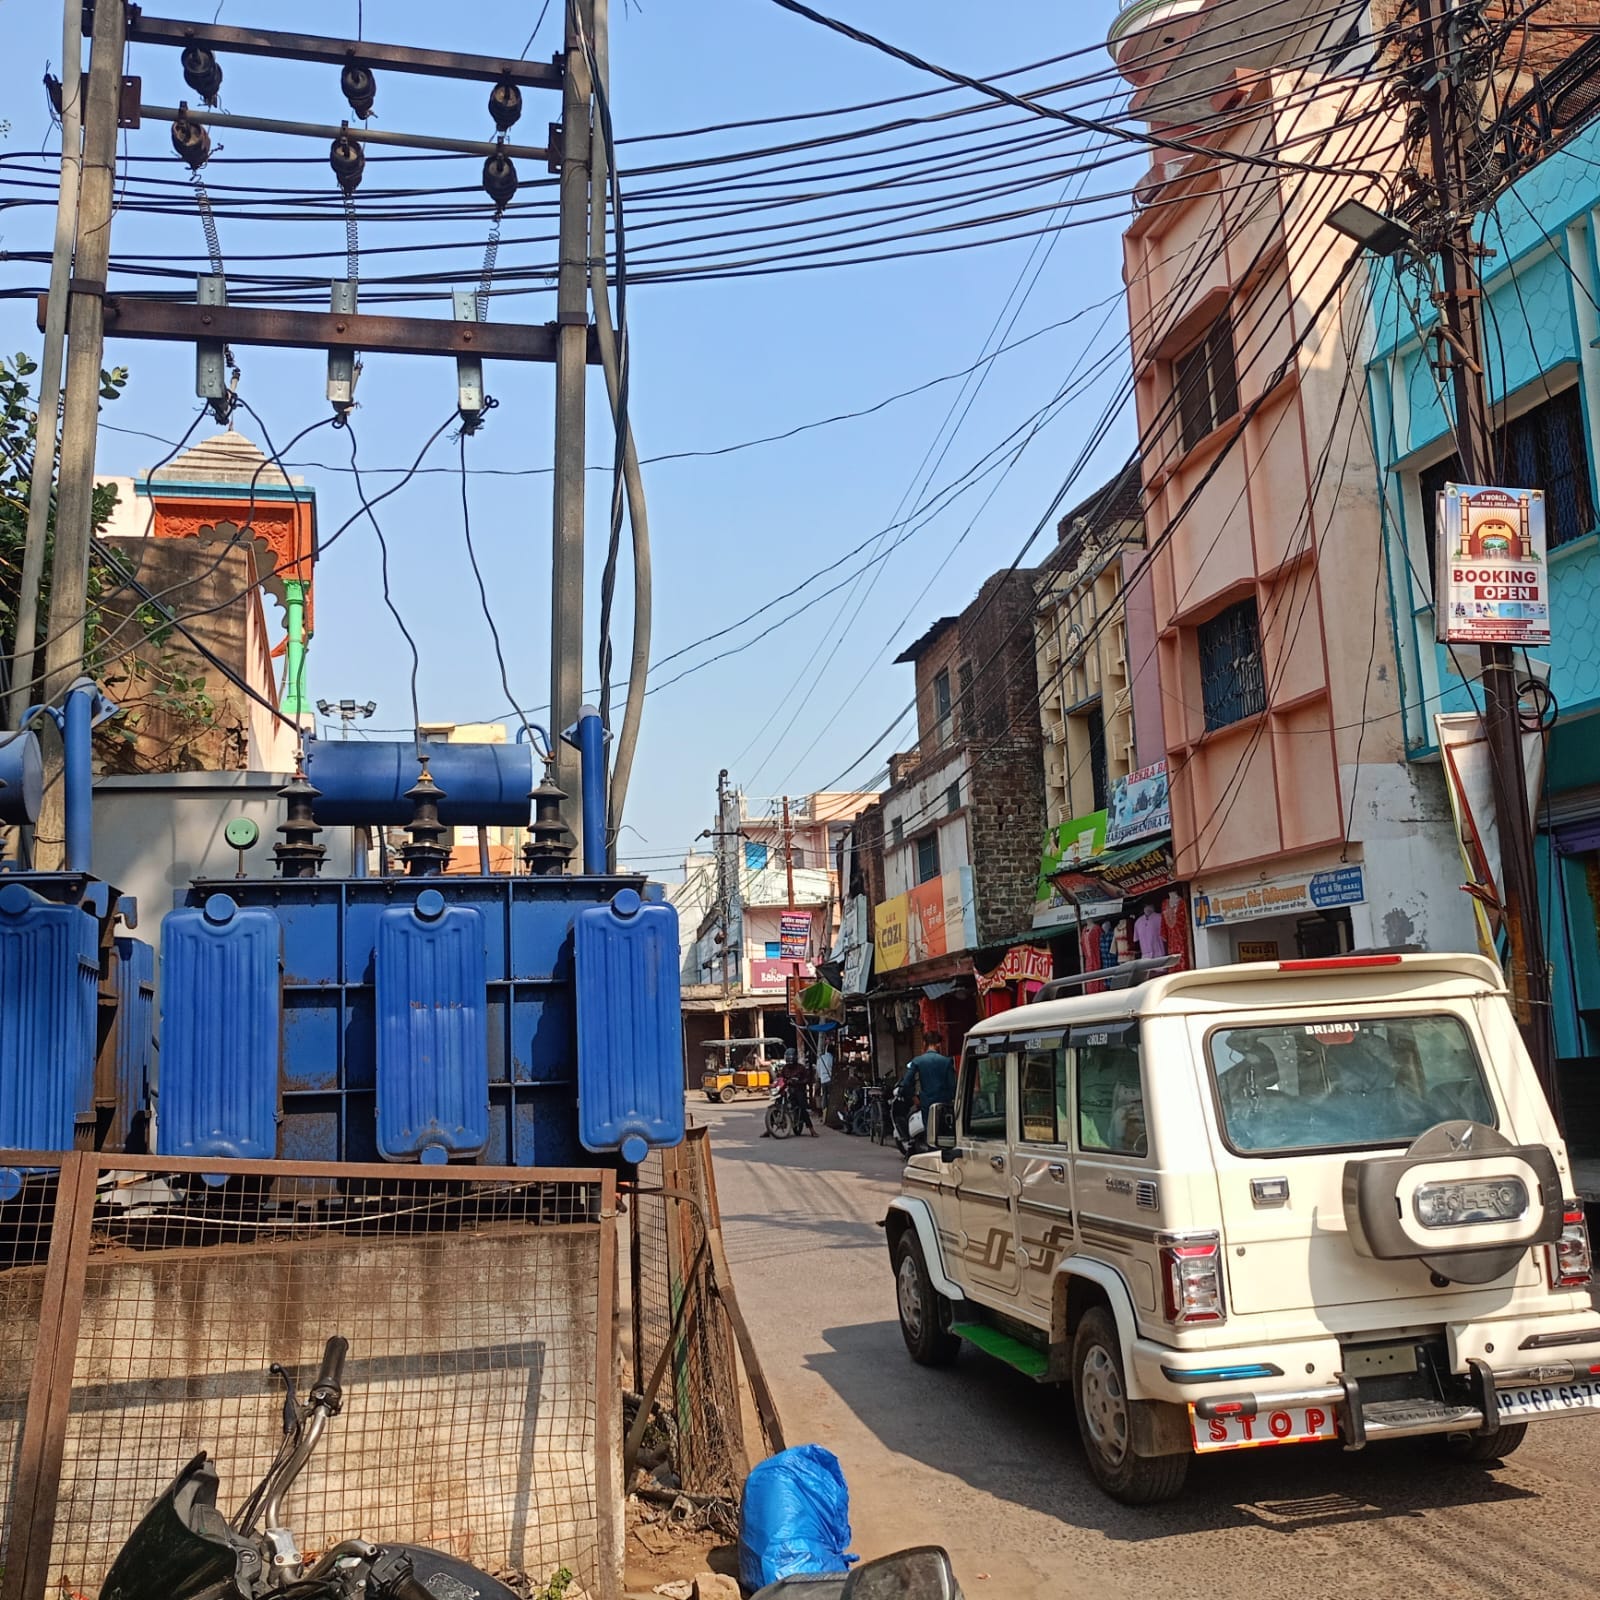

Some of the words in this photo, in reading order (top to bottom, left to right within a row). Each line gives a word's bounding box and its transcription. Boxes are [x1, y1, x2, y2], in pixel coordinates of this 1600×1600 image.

[1453, 569, 1537, 584] BOOKING
[1483, 586, 1530, 600] OPEN
[1128, 767, 1155, 785] HEERA
[881, 923, 902, 948] COZI
[1305, 1022, 1360, 1034] BRIJRAJ
[1432, 1186, 1517, 1214] BOLERO
[1208, 1407, 1326, 1442] STOP
